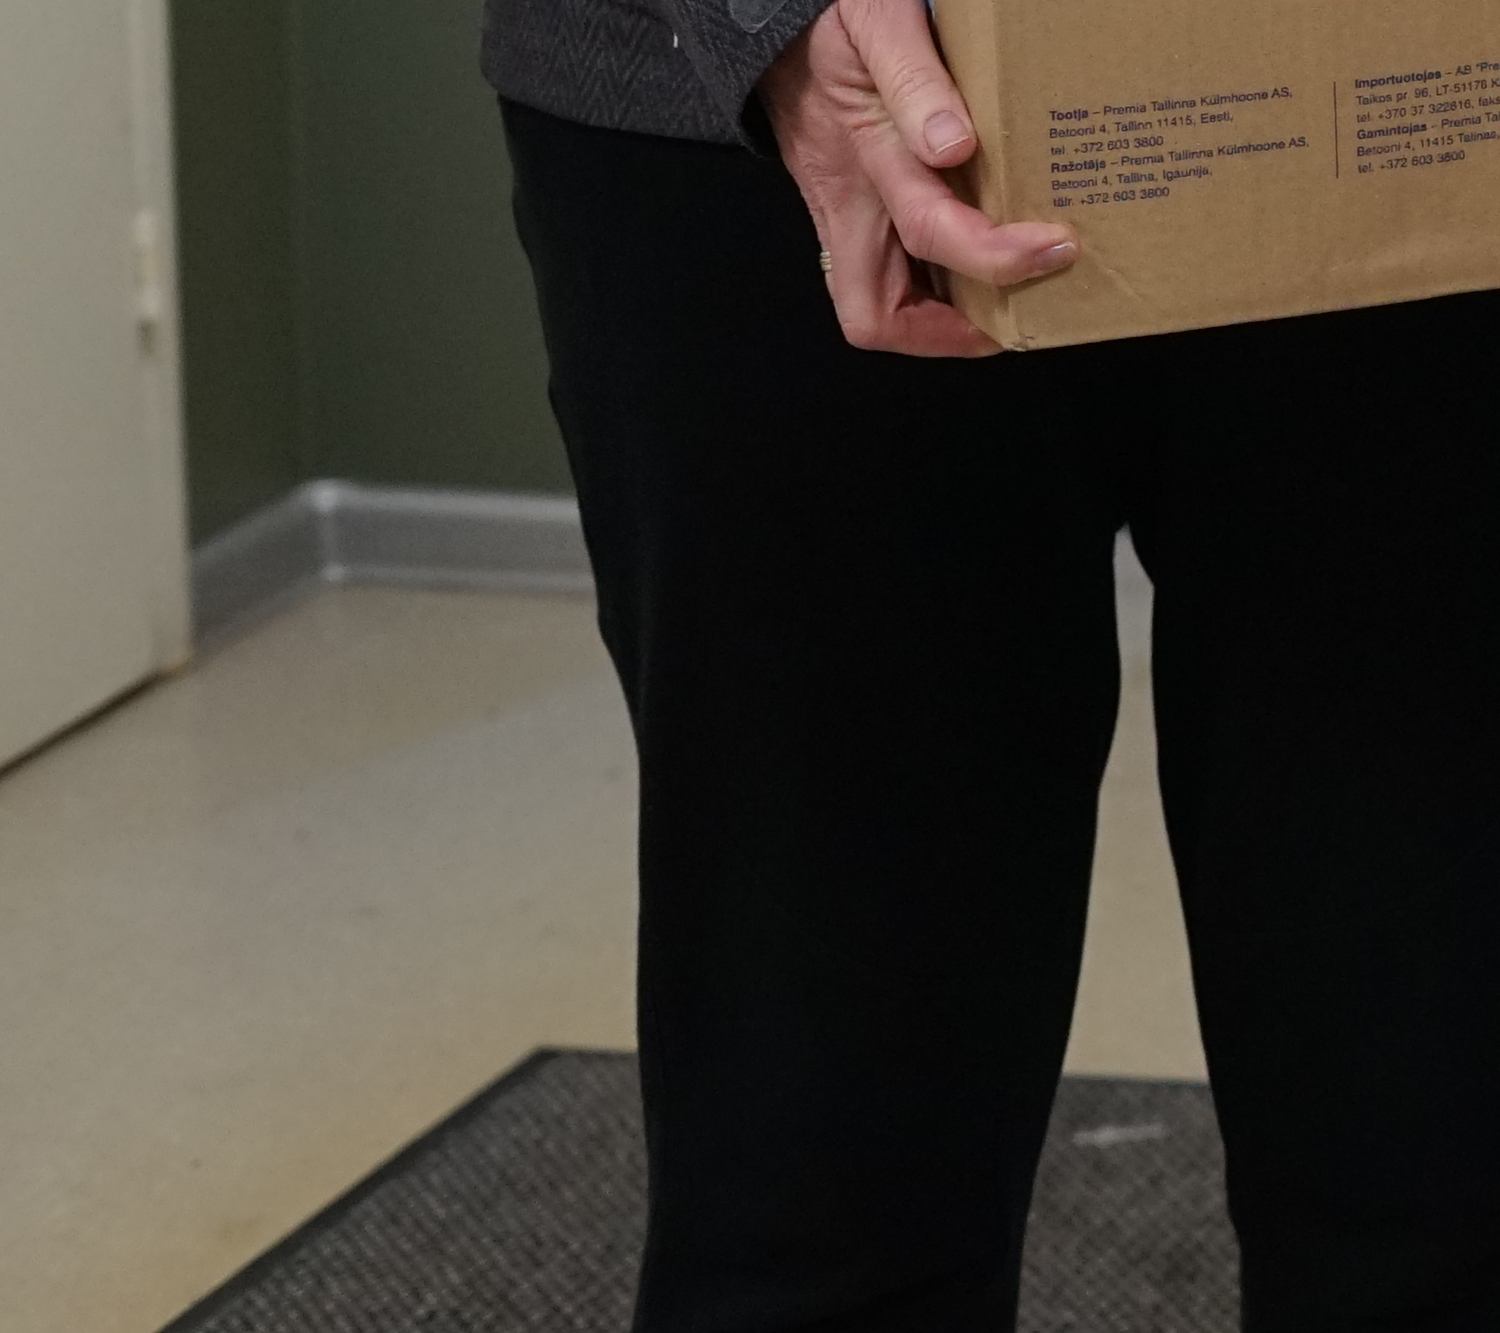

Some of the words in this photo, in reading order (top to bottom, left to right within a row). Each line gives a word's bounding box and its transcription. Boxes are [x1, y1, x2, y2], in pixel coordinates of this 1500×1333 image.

[1355, 70, 1442, 89] Importuotojas
[1050, 108, 1088, 121] Tootja
[1104, 105, 1146, 116] Premia
[1150, 99, 1196, 112] Tallinna
[1200, 91, 1268, 106] Külmhoone
[1271, 87, 1292, 99] AS,
[1050, 126, 1095, 139] Betooni
[1099, 125, 1110, 134] 4,
[1115, 120, 1152, 133] Tallinn
[1157, 116, 1196, 127] 11415,
[1200, 111, 1233, 124] Eesti,
[1357, 123, 1427, 140] Gamintojas
[1441, 116, 1481, 129] Premia
[1074, 141, 1103, 154] +372
[1107, 139, 1129, 151] 603
[1134, 136, 1164, 148] 3800
[1121, 155, 1164, 166] Premia
[1167, 149, 1213, 162] Tallinna
[1217, 140, 1285, 156] Külmhoone
[1081, 193, 1109, 205] +372
[1113, 190, 1135, 201] 603
[1140, 187, 1170, 199] 3800
